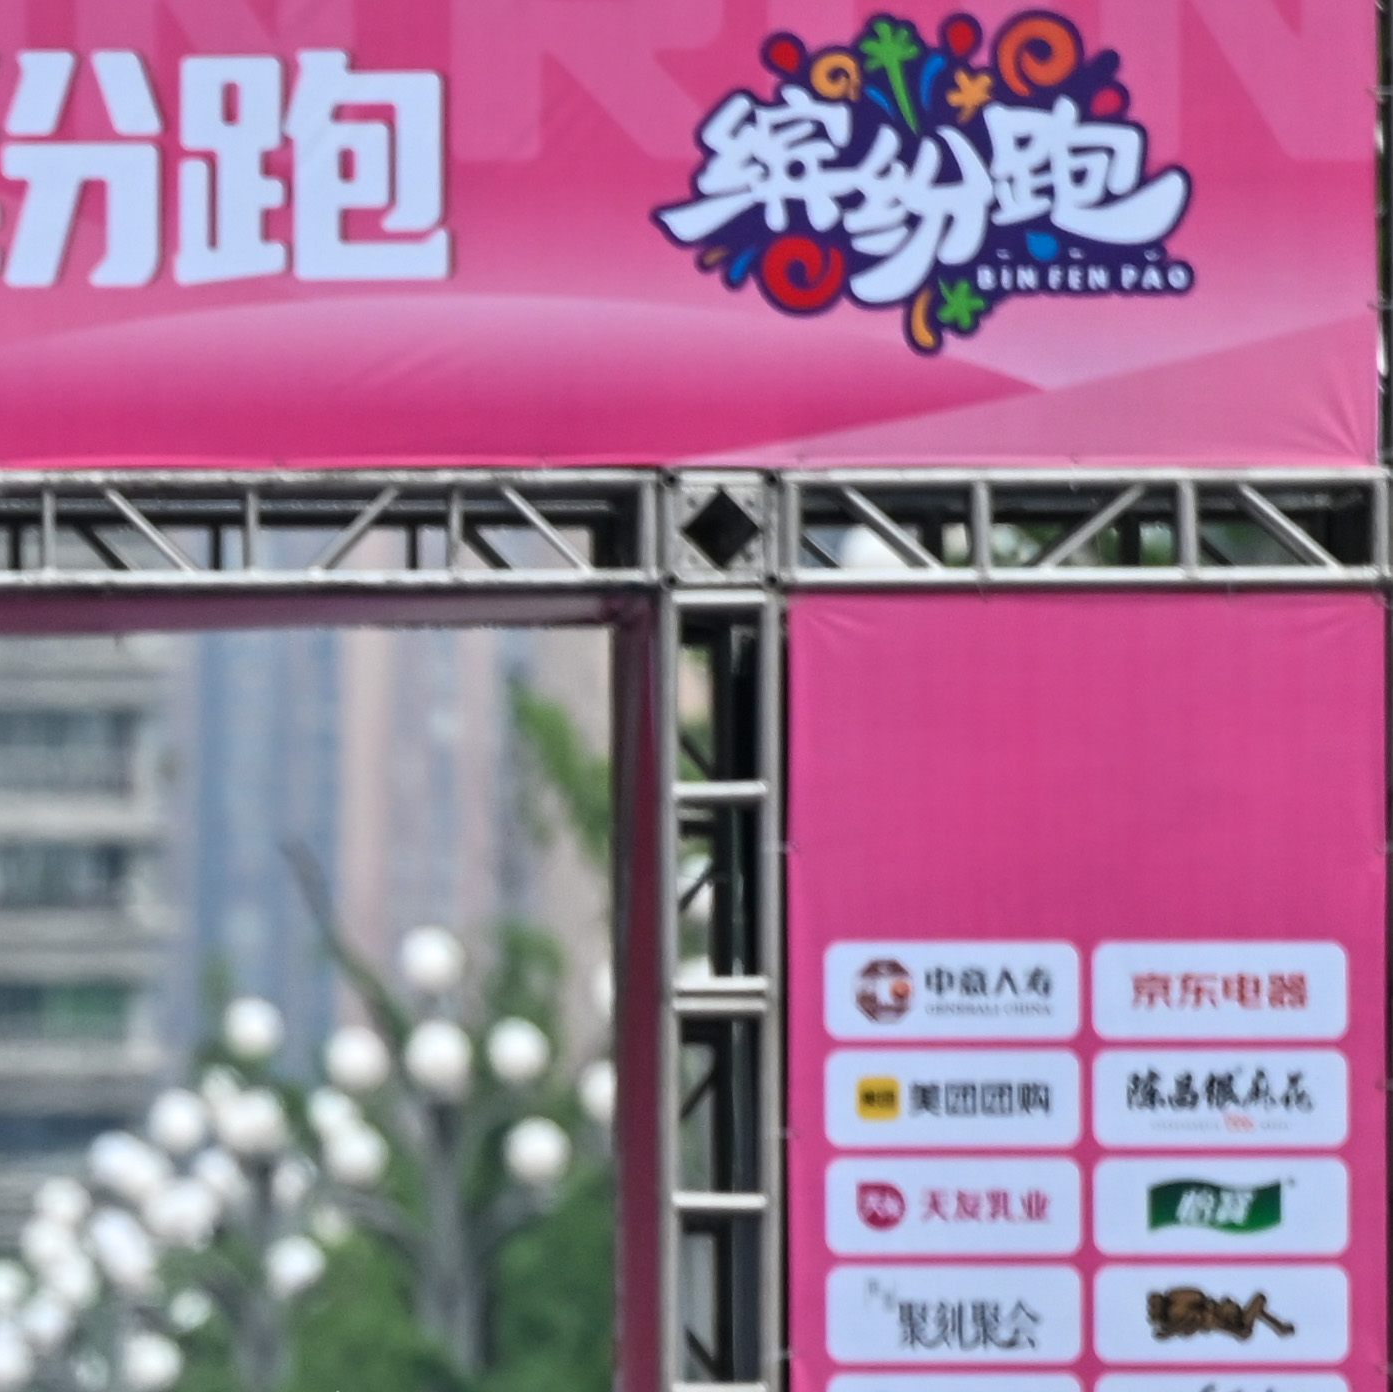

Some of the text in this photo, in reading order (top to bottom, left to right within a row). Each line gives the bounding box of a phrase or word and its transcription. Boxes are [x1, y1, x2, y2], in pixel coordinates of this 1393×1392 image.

[658, 85, 1188, 305] 缤纷跑
[1131, 971, 1308, 1009] 京东电器
[909, 1081, 1052, 1119] 美团团购
[921, 1189, 1051, 1222] 天友乳业
